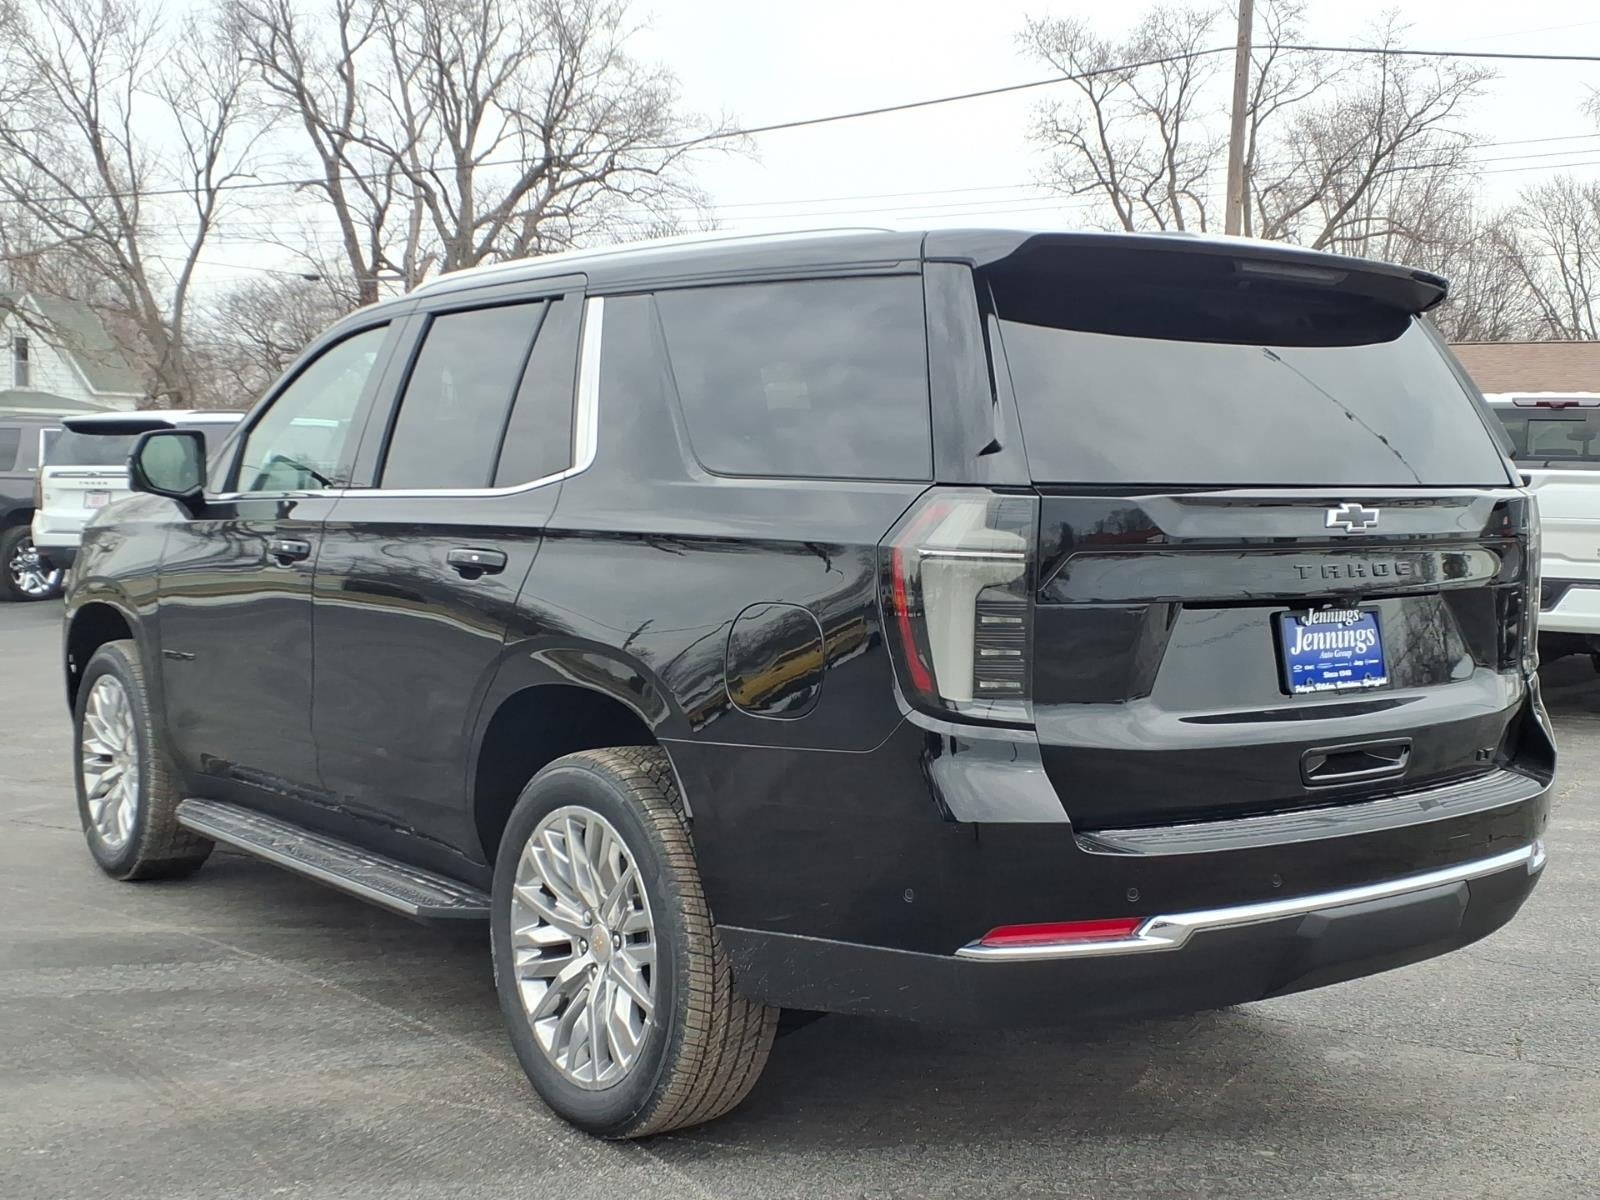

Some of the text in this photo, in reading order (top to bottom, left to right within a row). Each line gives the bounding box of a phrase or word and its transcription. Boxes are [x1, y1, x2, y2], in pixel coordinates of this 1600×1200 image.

[1293, 561, 1410, 580] TAHOE
[1305, 608, 1360, 625] Jennings
[1291, 623, 1376, 655] Jennings
